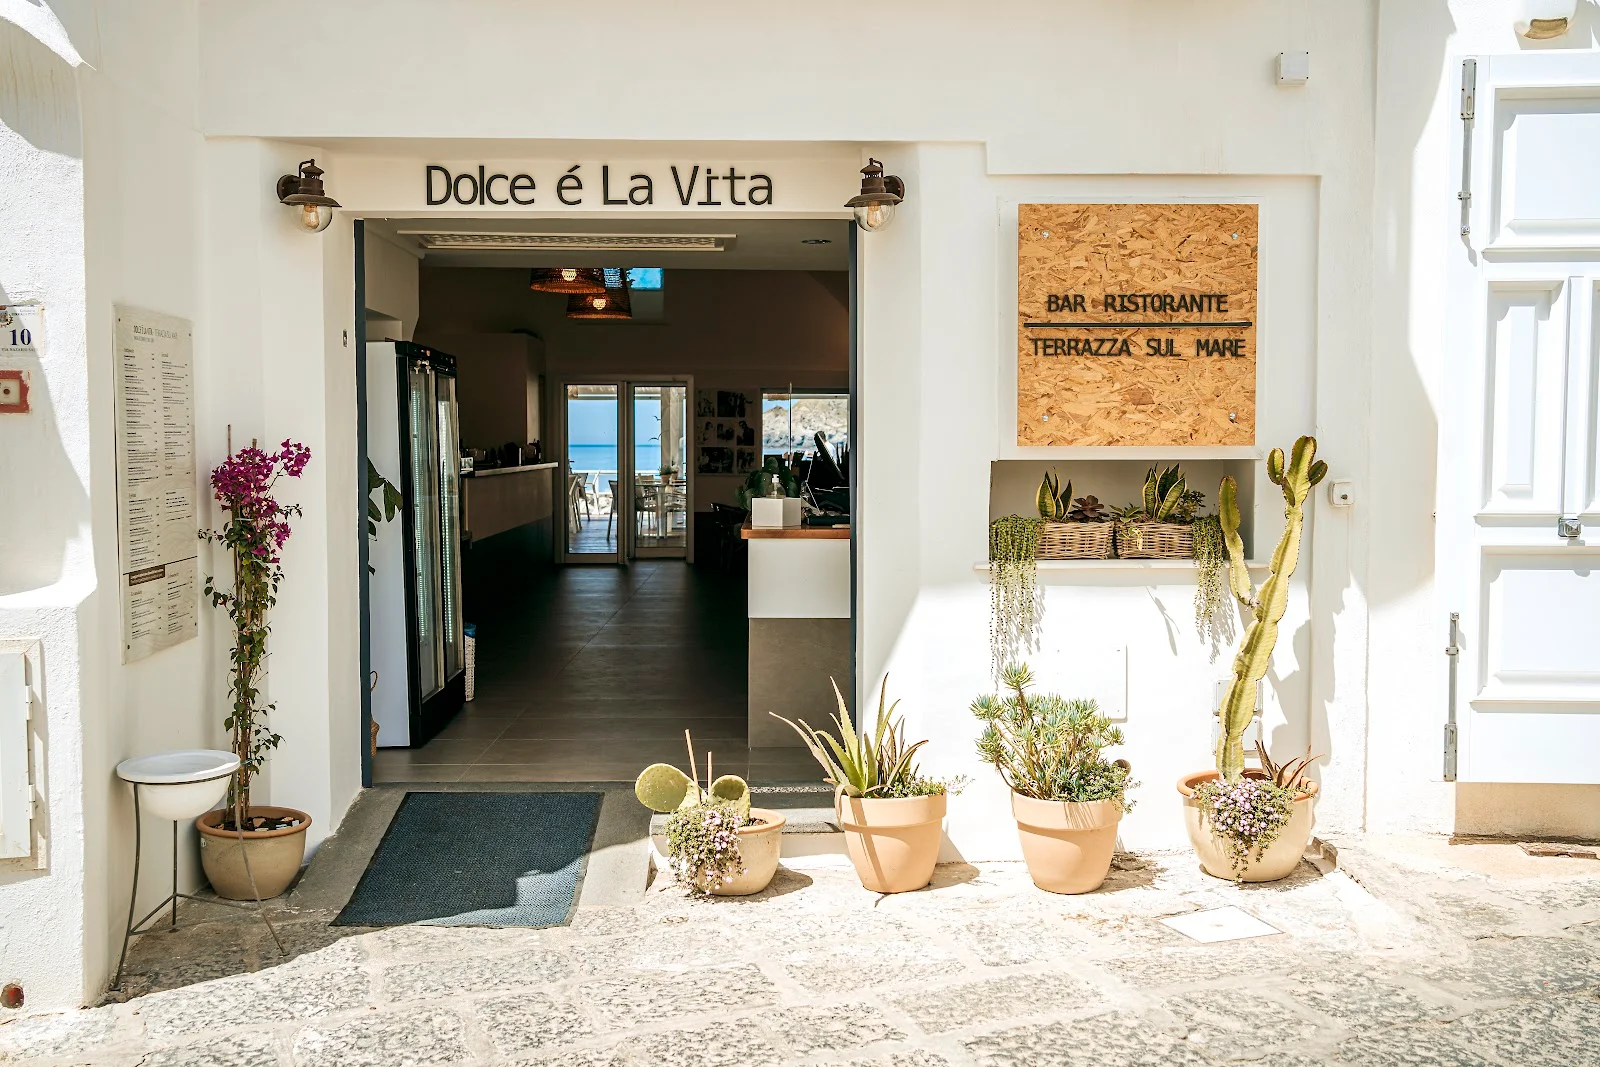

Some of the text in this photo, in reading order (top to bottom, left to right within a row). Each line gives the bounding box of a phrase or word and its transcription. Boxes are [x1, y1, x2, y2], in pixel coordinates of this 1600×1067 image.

[425, 164, 774, 206] Dolce é La Vita
[1047, 294, 1229, 313] BAR RISTORANTE
[9, 328, 32, 346] 10
[1031, 338, 1247, 357] TERRAZZA SUL MARE
